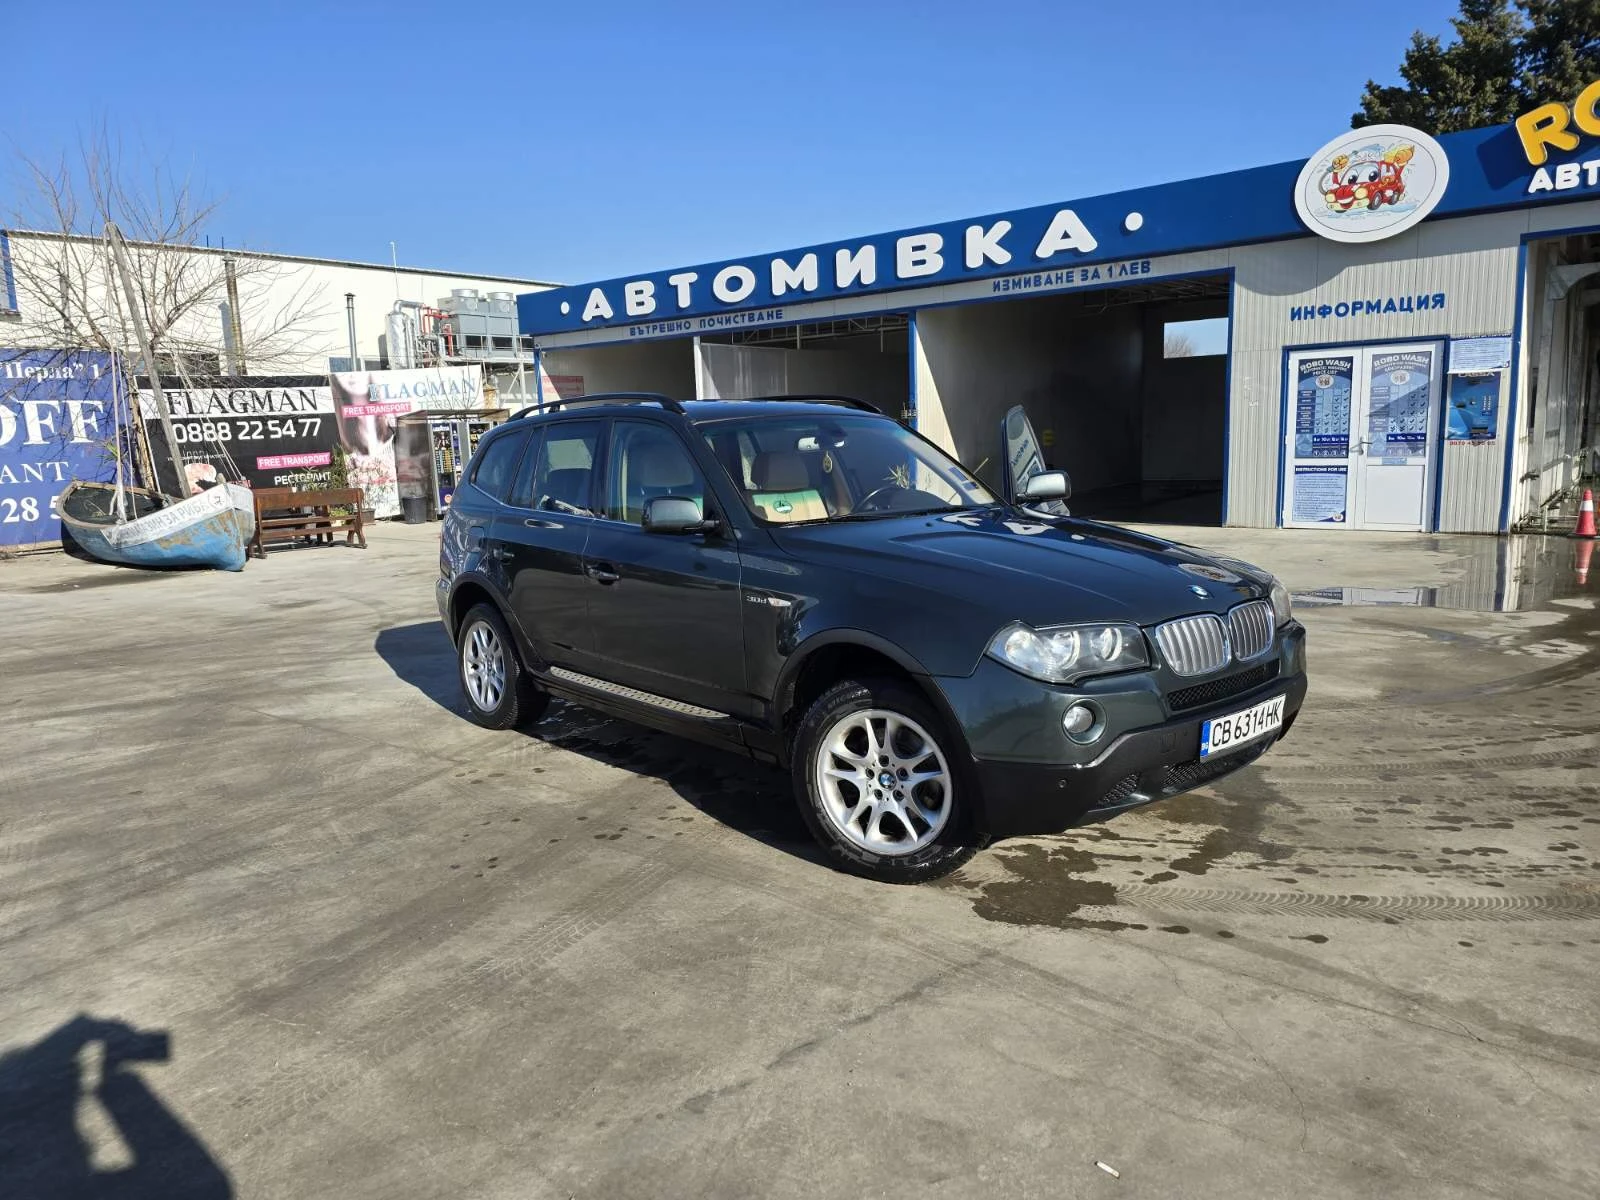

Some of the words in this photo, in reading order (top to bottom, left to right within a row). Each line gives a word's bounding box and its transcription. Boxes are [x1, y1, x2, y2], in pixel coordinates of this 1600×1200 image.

[582, 209, 1098, 322] АВТОМИВКА
[992, 270, 1075, 292] ИЗМИВАНЕ
[1080, 268, 1101, 281] ЗА
[1107, 267, 1114, 278] 1
[1118, 261, 1151, 276] ЛЕВ
[1290, 293, 1446, 321] ИНФОРМАЦИЯ
[629, 320, 691, 336] ВЪТРЕШНО
[700, 309, 784, 328] ПОЧИСТВАНЕ
[164, 389, 319, 415] FLAGMAN
[370, 379, 476, 402] FLAGMAN
[343, 407, 365, 416] FREE
[366, 404, 410, 414] TRANSPORT
[174, 422, 232, 443] 0888
[236, 421, 264, 440] 22
[268, 419, 296, 439] 54
[298, 418, 322, 437] 77
[0, 461, 69, 484] ANT
[259, 458, 281, 467] FREE
[282, 455, 329, 465] TRANSPORT
[274, 472, 331, 486] РЕСТОРАНТ
[1, 496, 40, 523] 28
